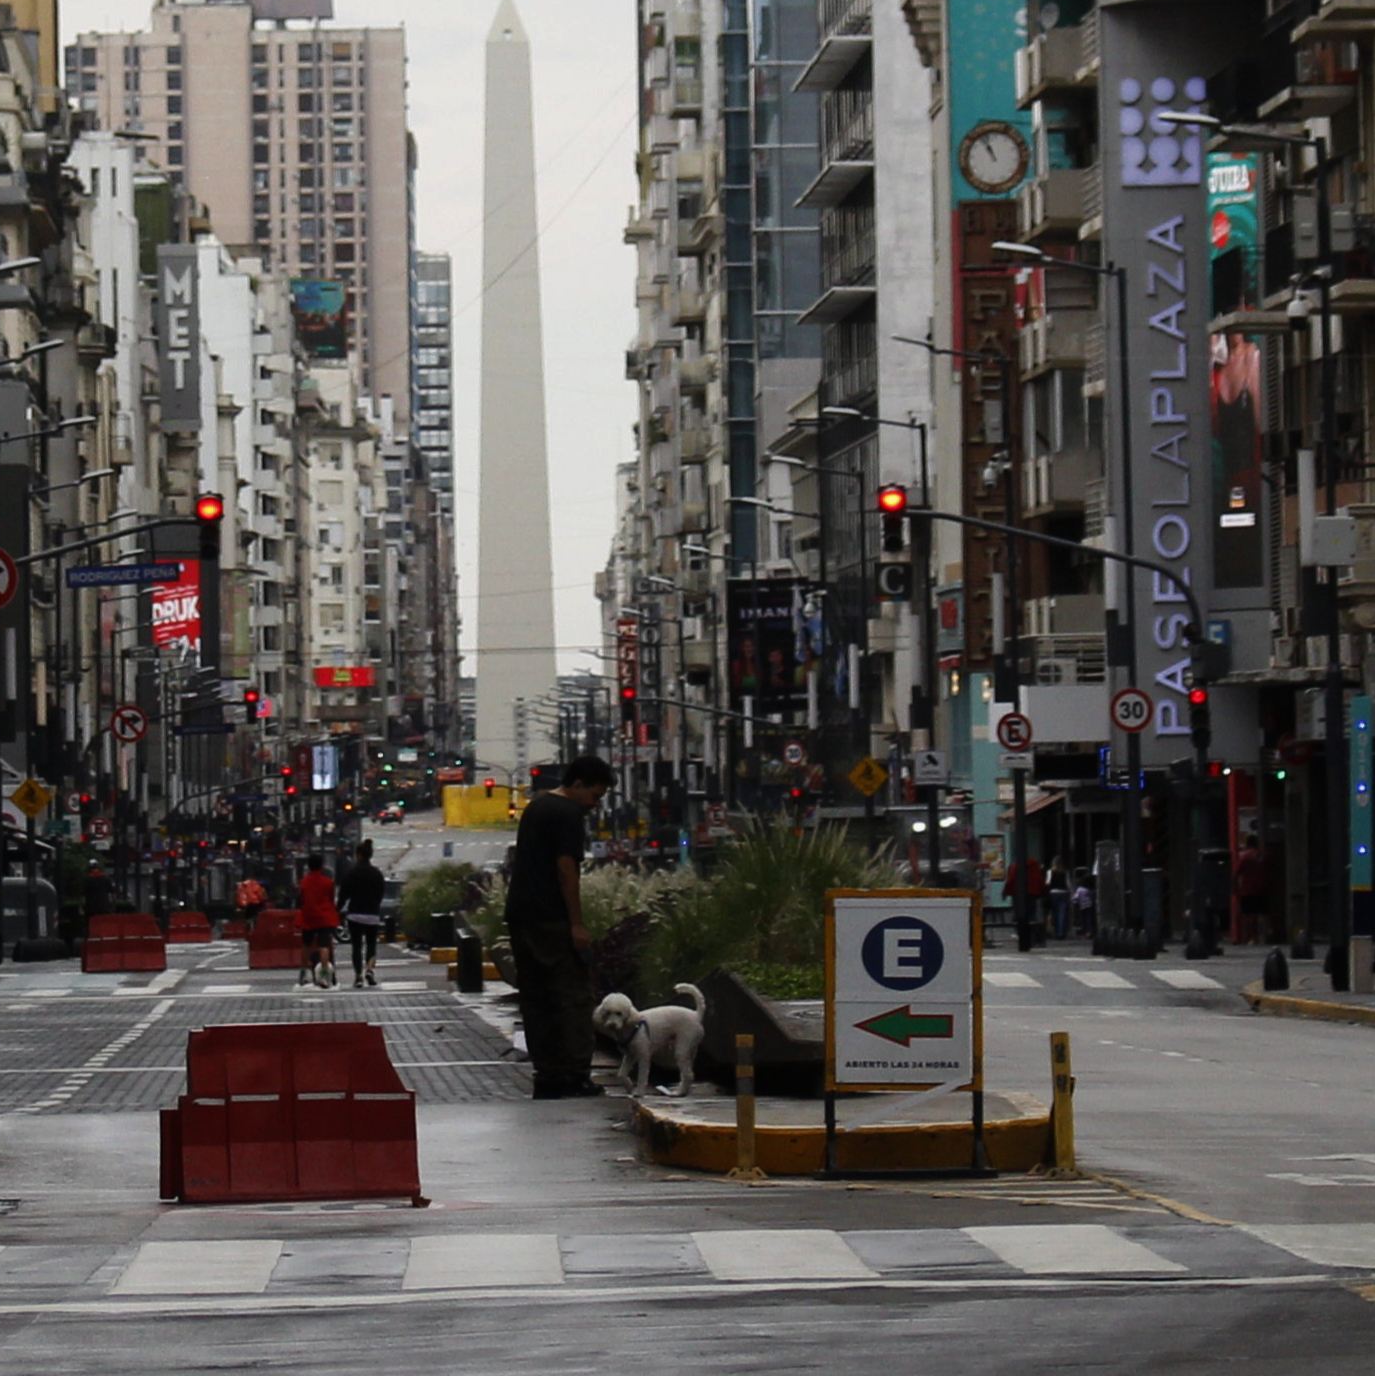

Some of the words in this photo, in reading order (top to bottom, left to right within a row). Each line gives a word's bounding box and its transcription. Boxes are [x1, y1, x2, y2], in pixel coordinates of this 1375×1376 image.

[164, 265, 191, 390] MET
[70, 568, 140, 584] RODRIGUEZ
[879, 565, 905, 594] C
[152, 595, 201, 627] DRUK
[1119, 701, 1144, 720] 30
[882, 928, 923, 978] E
[845, 1060, 889, 1069] ABIERTO
[890, 1060, 910, 1069] LAS
[911, 1060, 924, 1069] 24
[926, 1060, 960, 1069] HORAS
